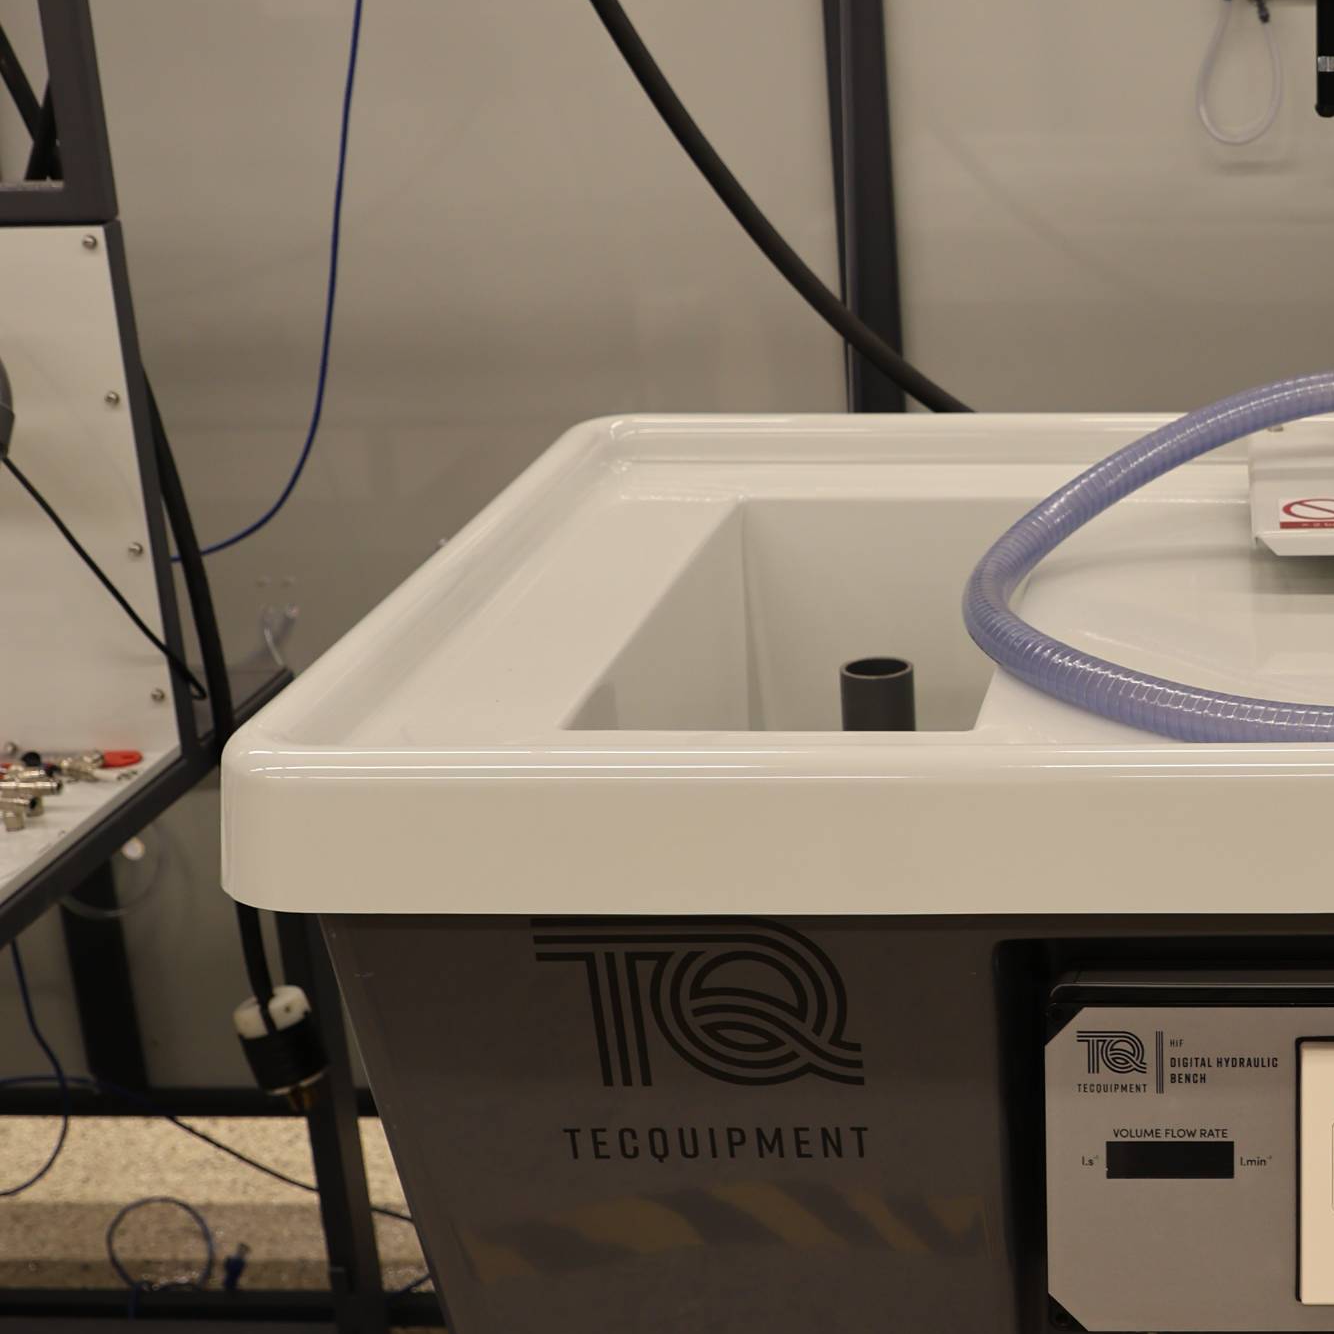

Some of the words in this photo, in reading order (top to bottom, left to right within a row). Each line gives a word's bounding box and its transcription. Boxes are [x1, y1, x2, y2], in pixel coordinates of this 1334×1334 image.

[530, 917, 865, 1087] TQ
[1076, 1030, 1148, 1075] TQ
[1169, 1057, 1212, 1068] DIGITAL
[1216, 1057, 1279, 1068] HYDRAULIC
[1169, 1073, 1207, 1084] BENCH
[1077, 1083, 1148, 1094] TECQUIPMENT
[1112, 1128, 1162, 1139] VOLUME
[1165, 1128, 1197, 1139] FLOW
[1199, 1128, 1229, 1139] RATE
[563, 1125, 869, 1163] TECQUIPMENT
